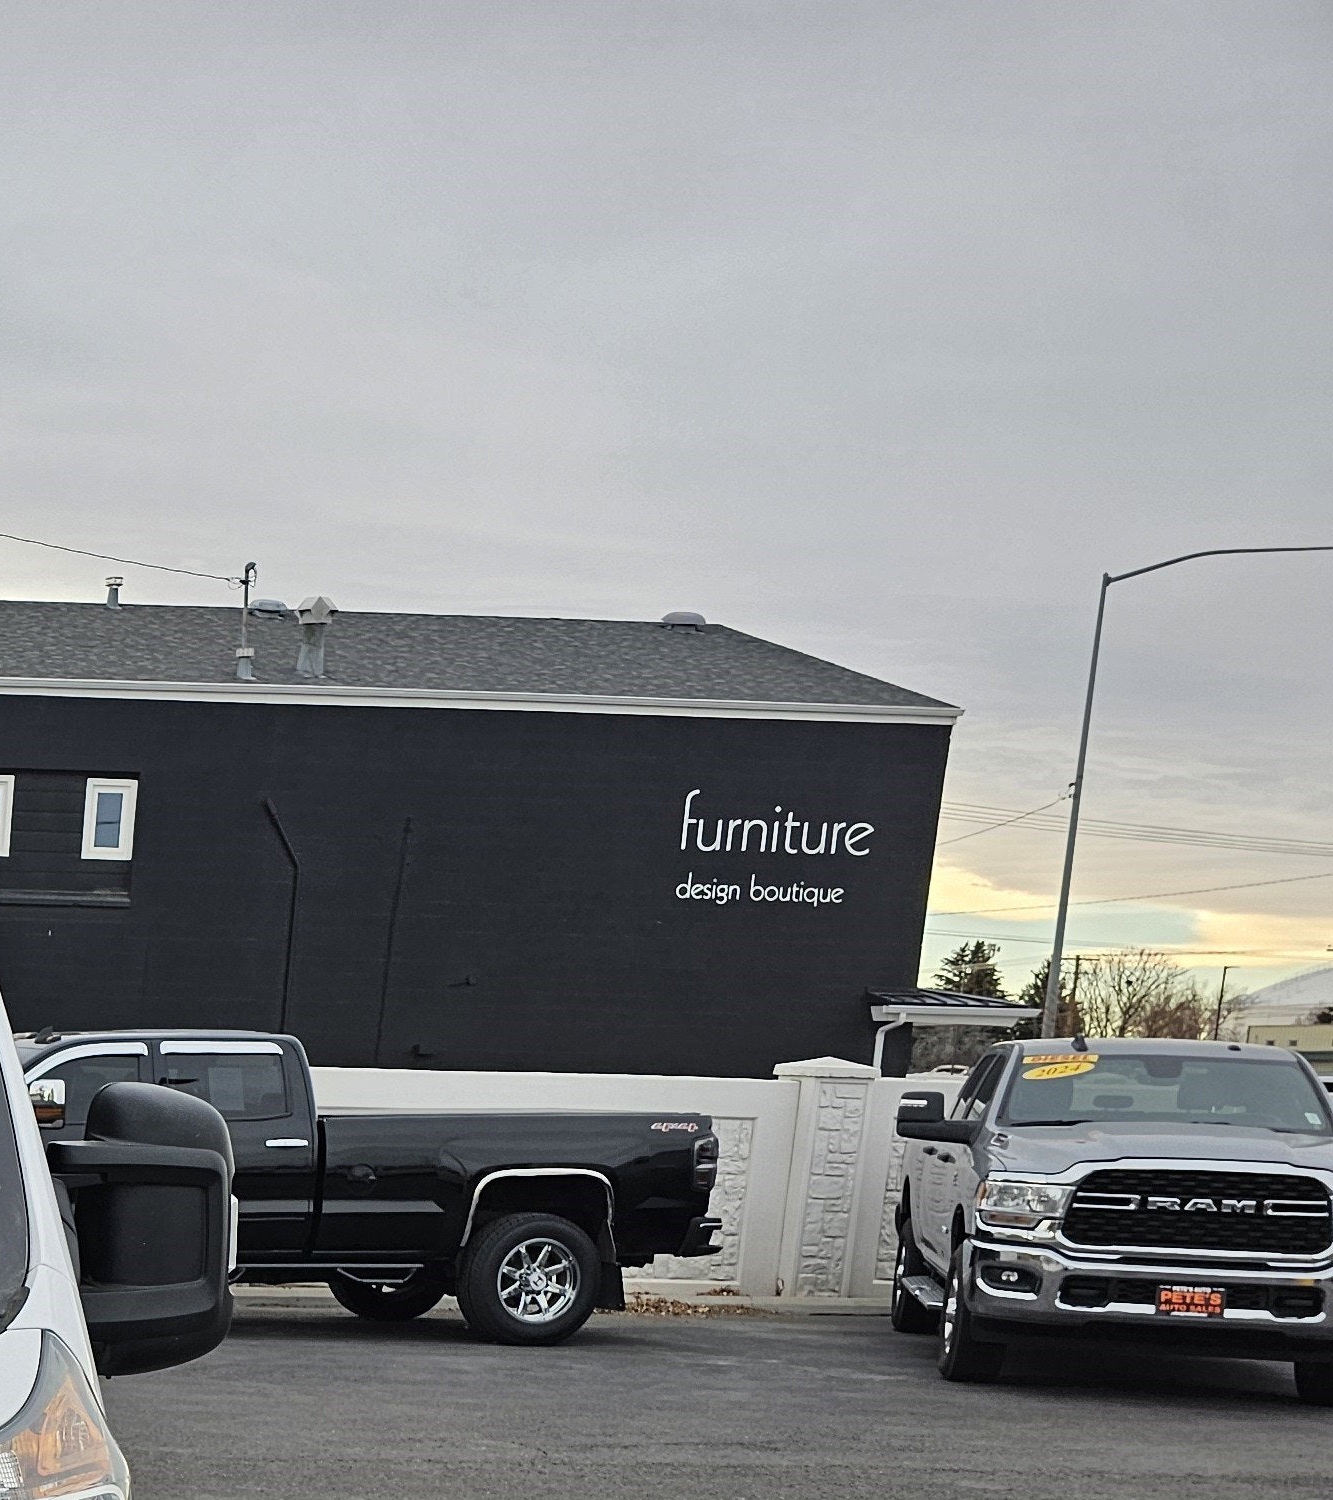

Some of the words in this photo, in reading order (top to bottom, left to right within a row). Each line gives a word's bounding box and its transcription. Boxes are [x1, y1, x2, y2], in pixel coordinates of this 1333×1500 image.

[679, 788, 876, 857] furniture
[674, 871, 741, 906] design
[749, 873, 846, 908] boutique
[1146, 1196, 1257, 1214] RAM
[1159, 1290, 1222, 1305] PETE'S
